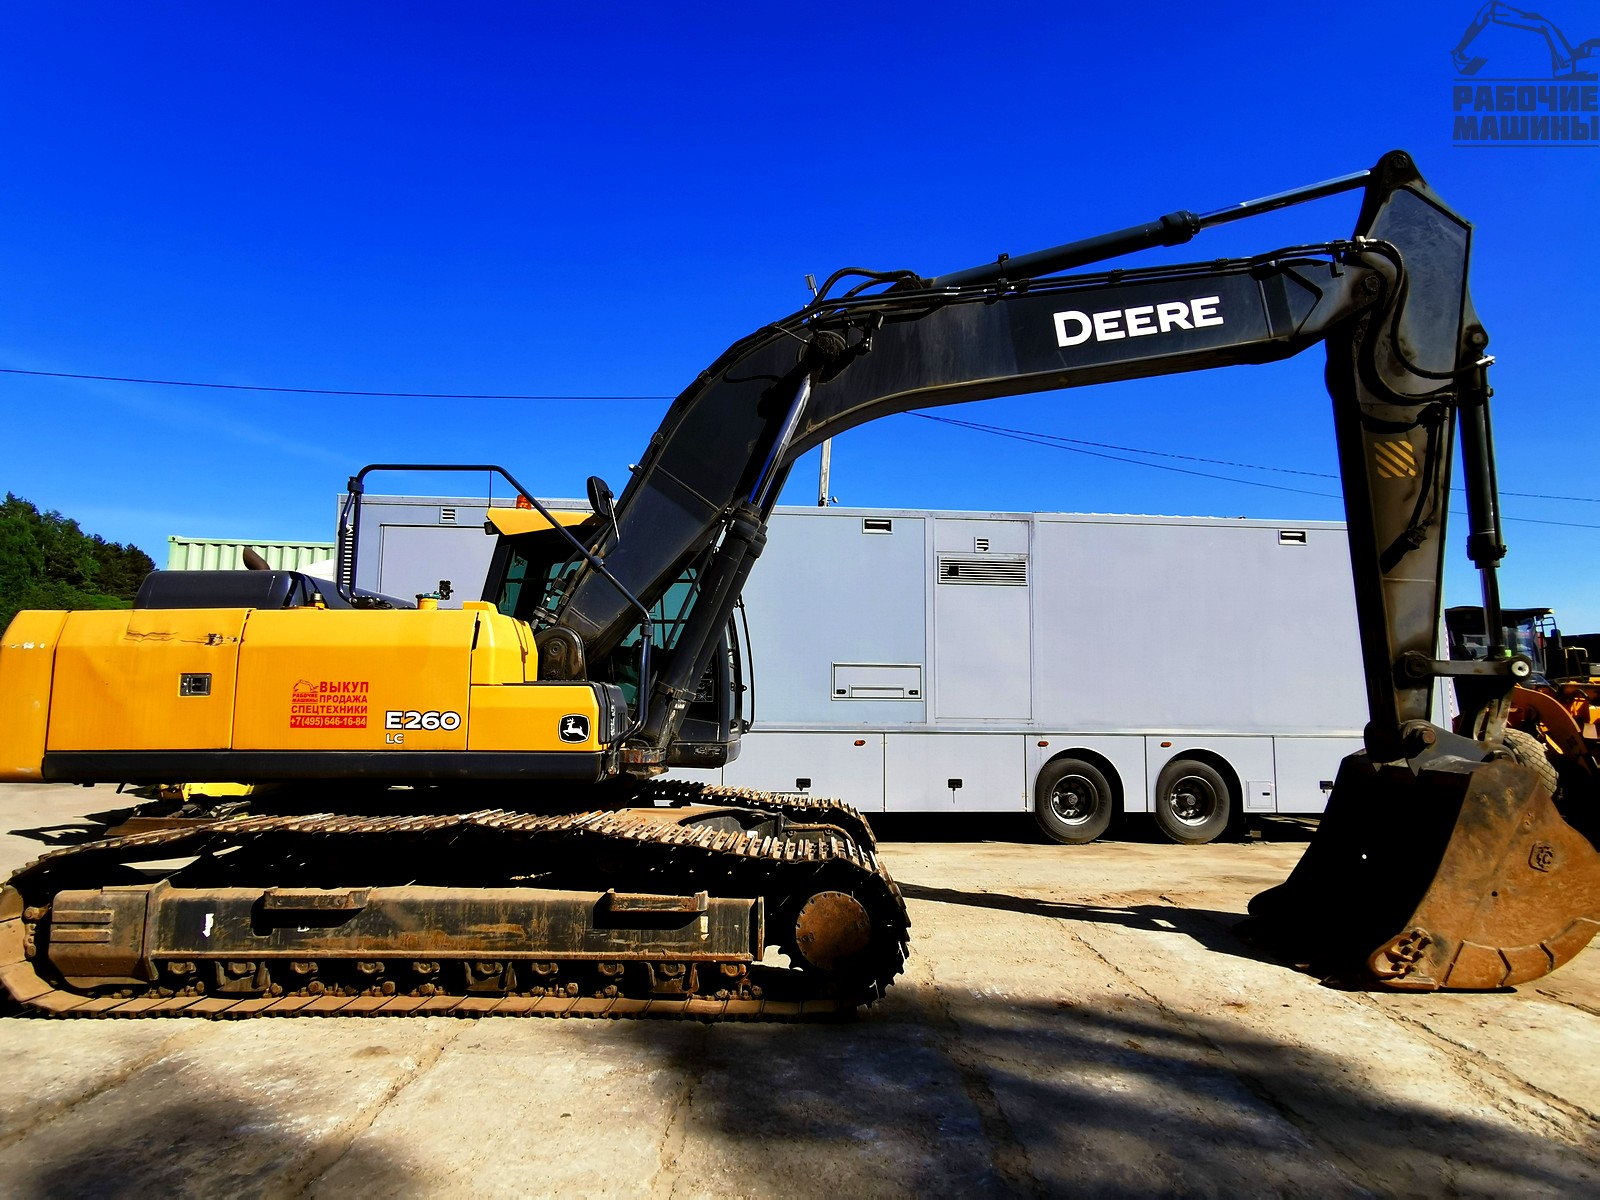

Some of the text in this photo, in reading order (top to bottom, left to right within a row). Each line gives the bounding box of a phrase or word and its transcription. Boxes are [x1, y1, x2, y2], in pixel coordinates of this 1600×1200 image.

[1053, 296, 1224, 347] DEERE
[319, 681, 369, 693] ВЫКУП
[319, 695, 368, 704] ПРОДАЖА
[291, 705, 368, 715] СПЕЦТЕХНИКИ
[385, 710, 461, 730] E260
[386, 733, 404, 744] LC
